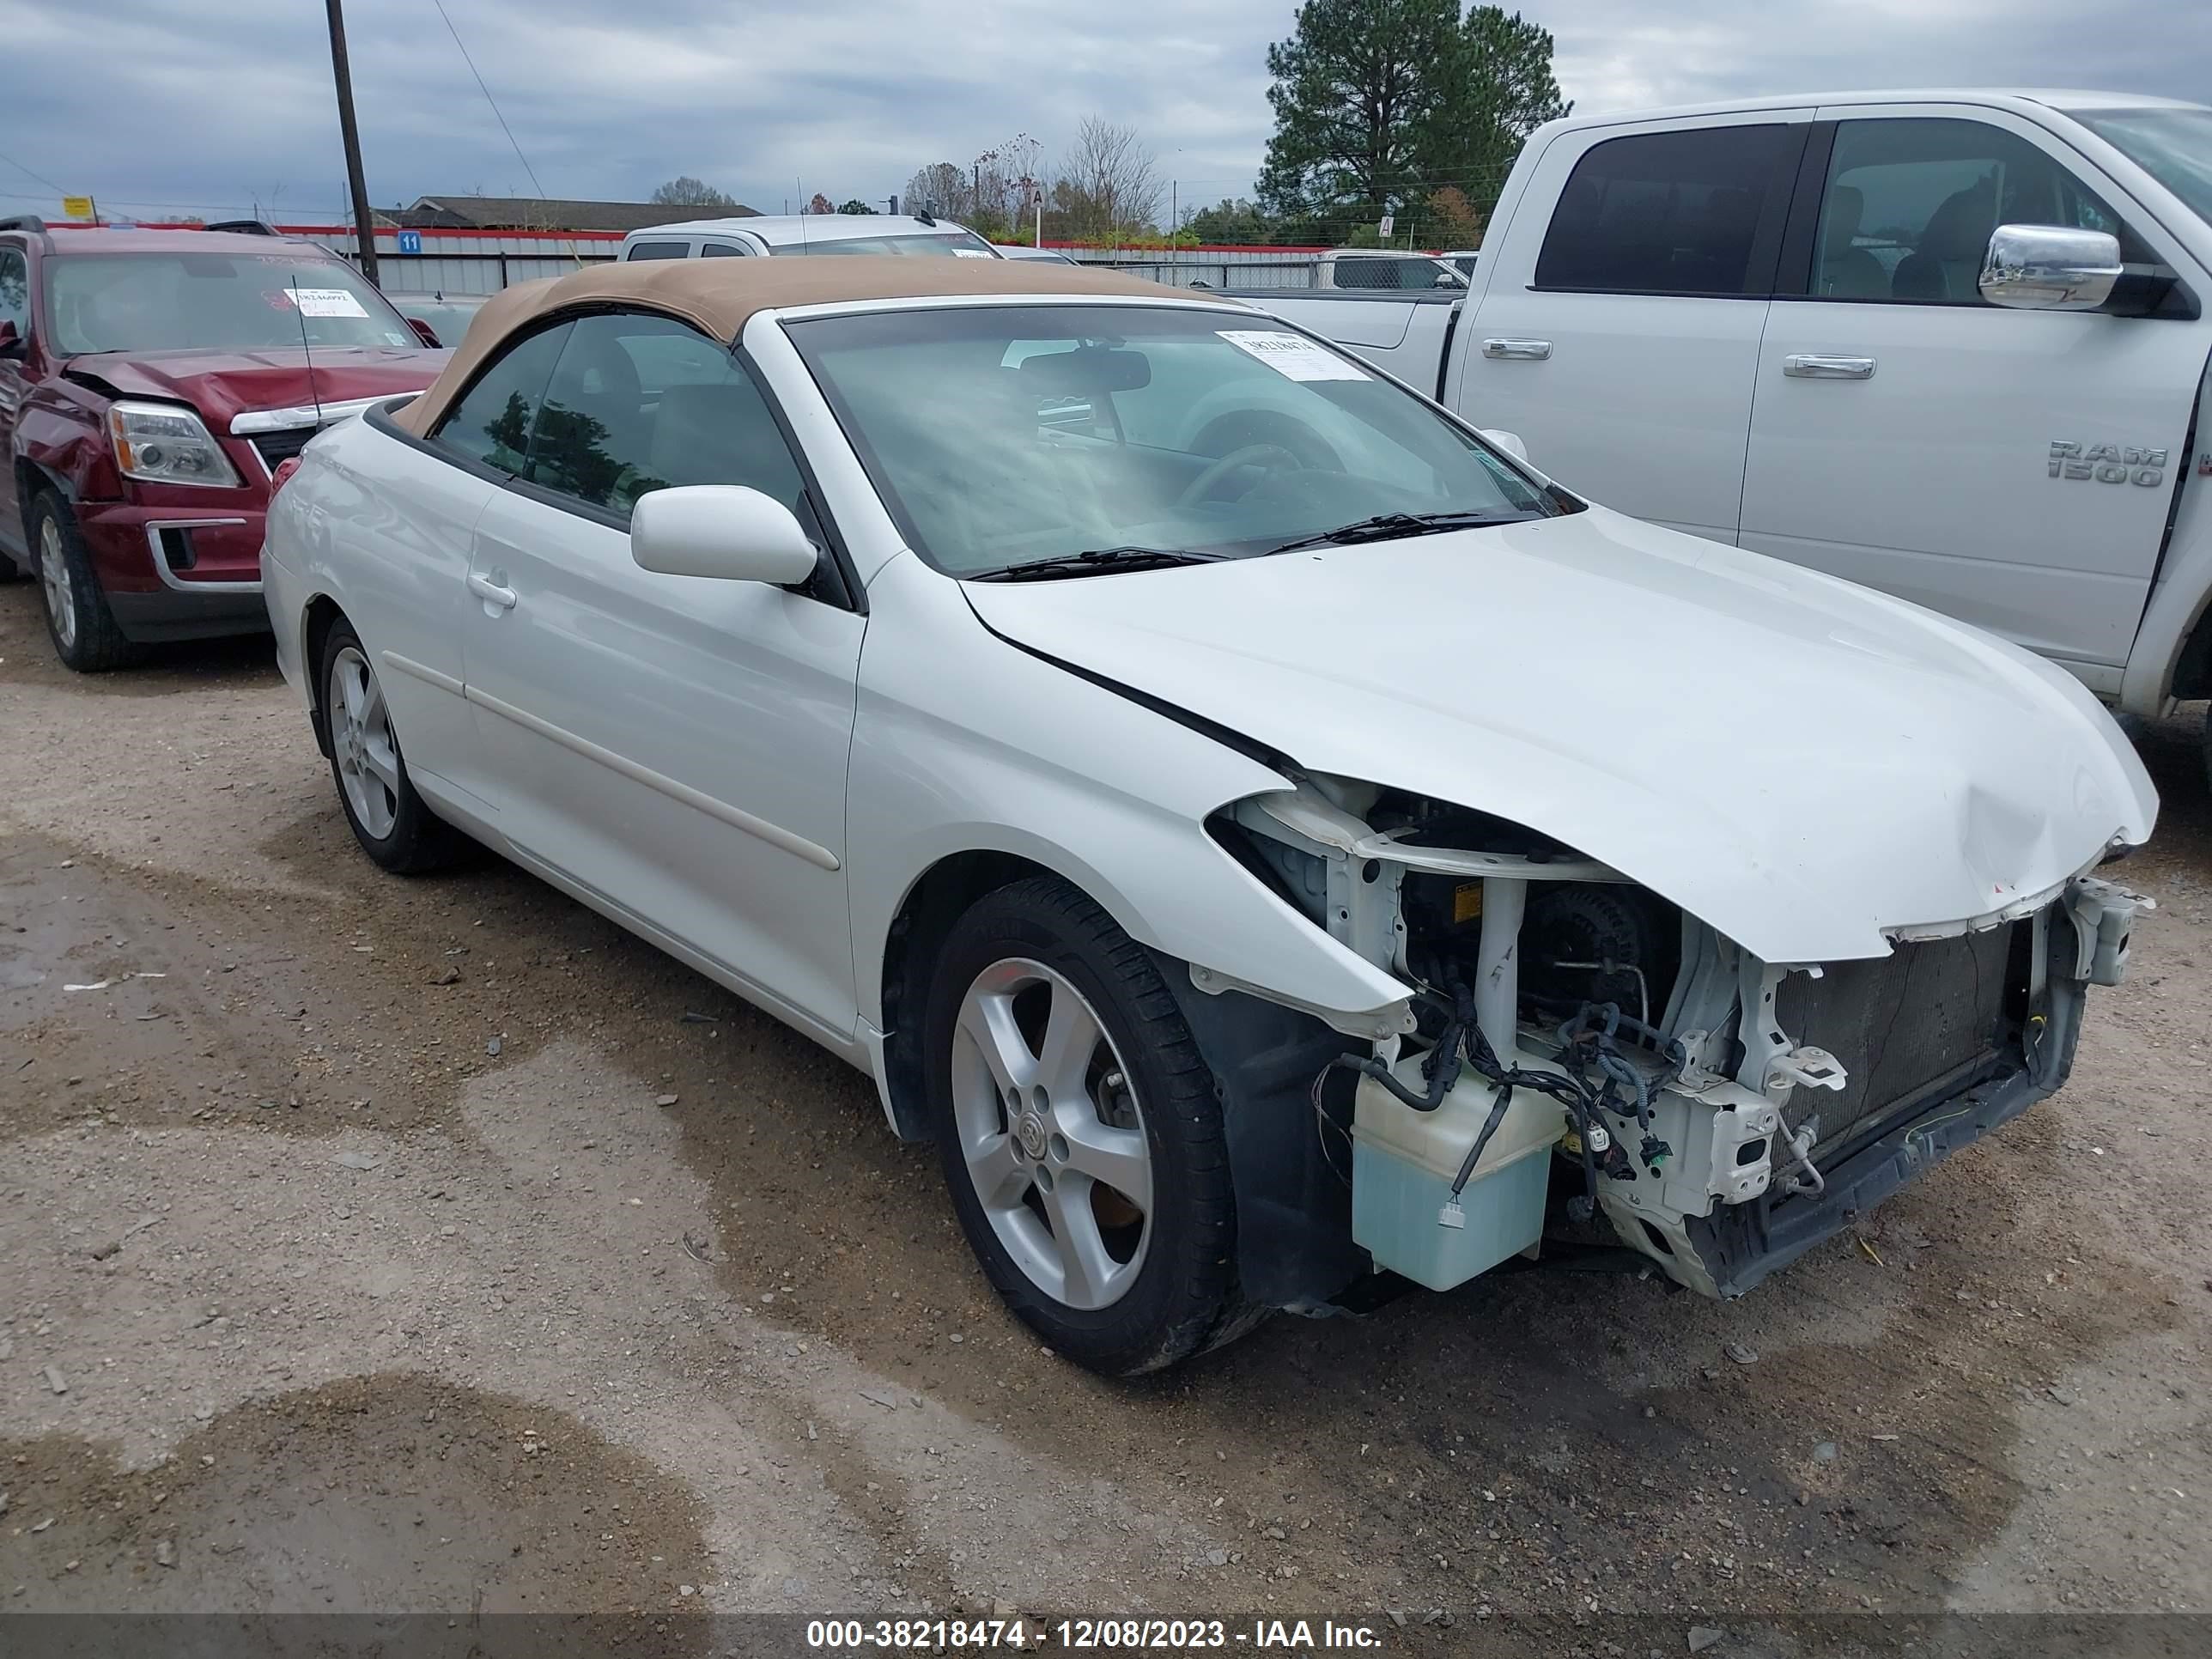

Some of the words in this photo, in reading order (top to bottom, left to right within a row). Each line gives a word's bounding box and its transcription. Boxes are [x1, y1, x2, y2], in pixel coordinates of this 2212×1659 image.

[1033, 190, 1042, 204] A
[1381, 218, 1389, 236] A
[403, 234, 417, 250] 11
[2049, 440, 2168, 467] RAM
[2048, 459, 2163, 488] 1500
